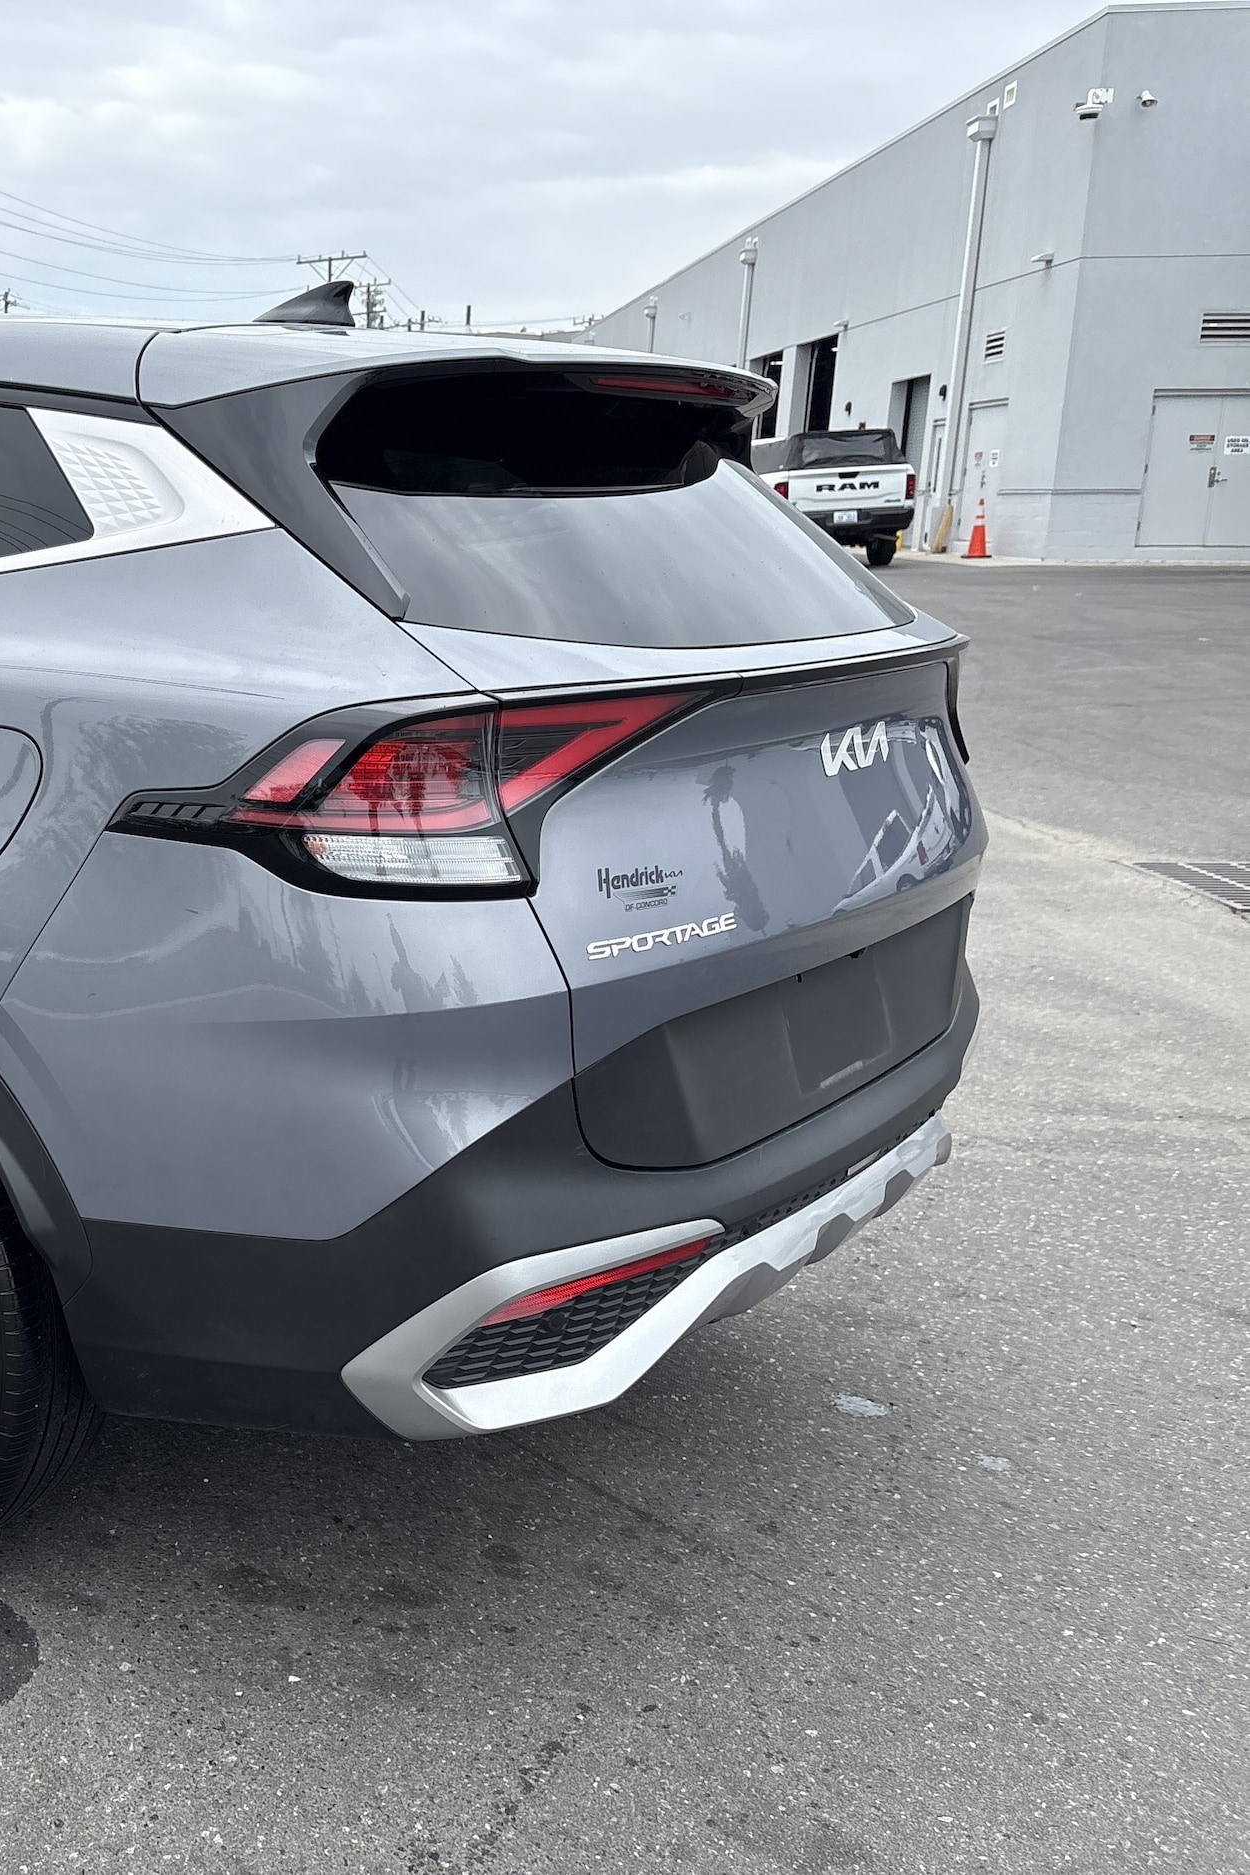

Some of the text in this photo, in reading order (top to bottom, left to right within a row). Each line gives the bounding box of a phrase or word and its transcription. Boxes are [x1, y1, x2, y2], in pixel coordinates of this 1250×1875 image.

[815, 481, 880, 492] RAM
[820, 721, 889, 777] KIA
[597, 865, 664, 899] Hendrick
[625, 898, 668, 911] OF CONCORD
[586, 912, 738, 960] SPORTAGE
